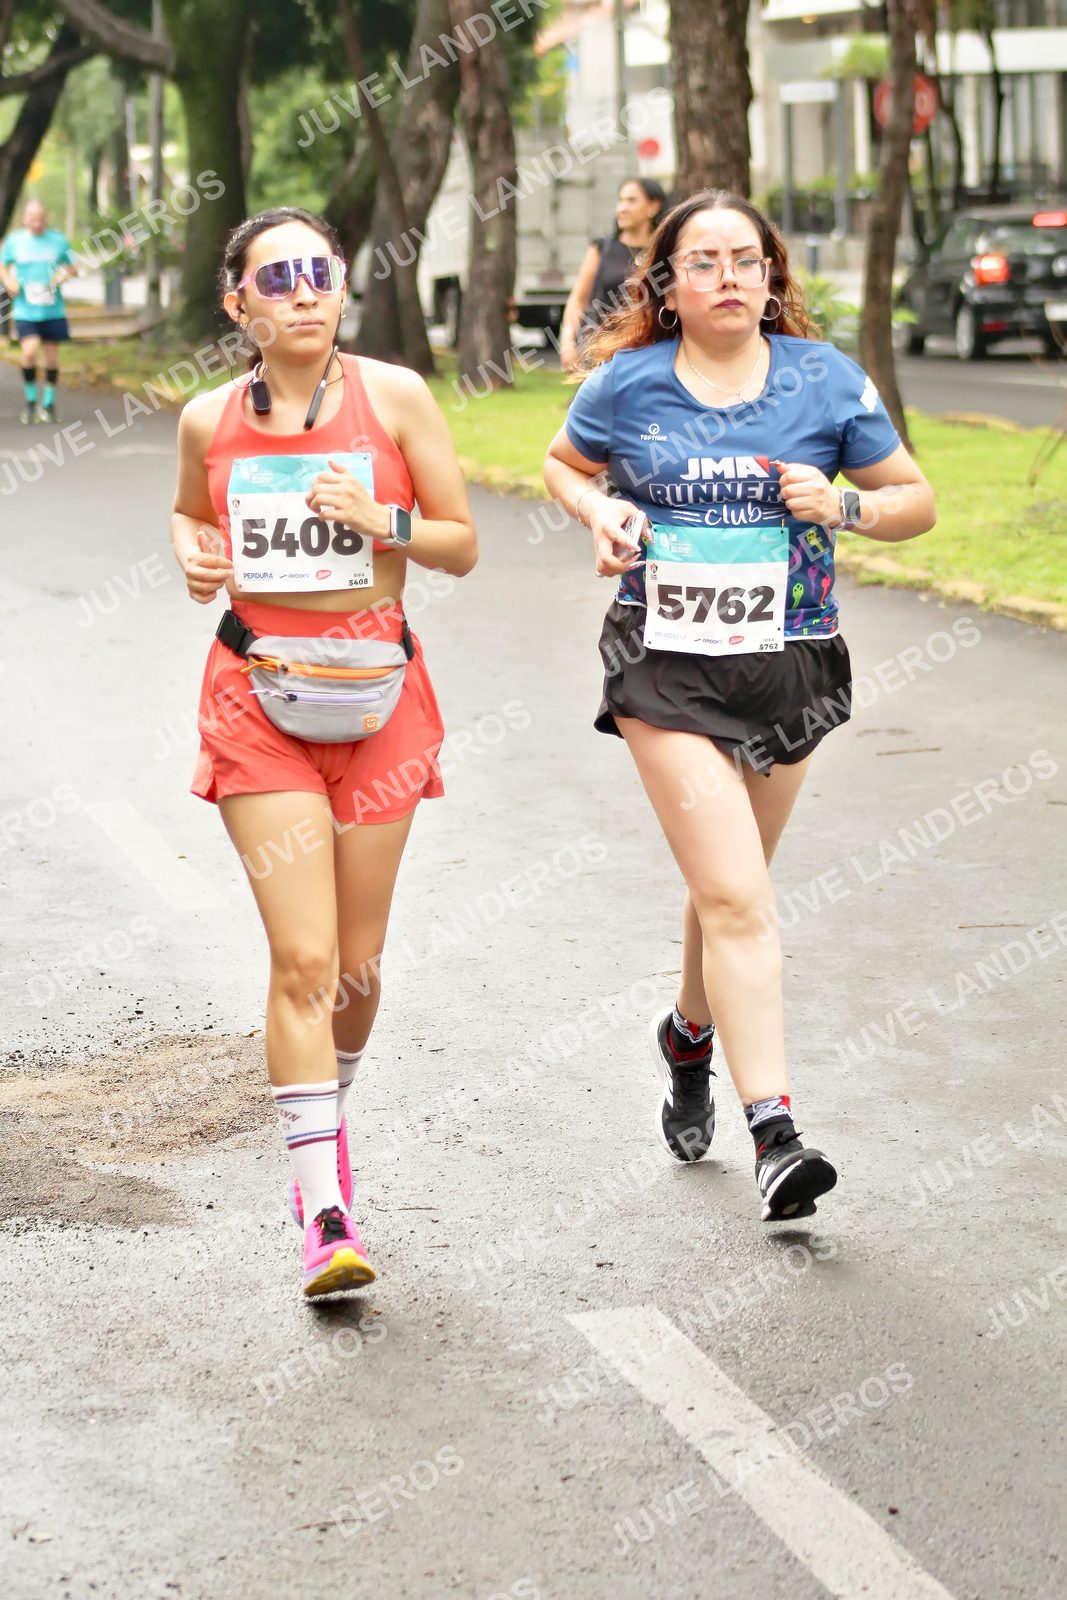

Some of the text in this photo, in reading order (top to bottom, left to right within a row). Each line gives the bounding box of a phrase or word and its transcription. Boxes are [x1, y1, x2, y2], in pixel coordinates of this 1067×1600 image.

[680, 456, 770, 481] JMA
[704, 502, 762, 526] club
[241, 516, 364, 559] 5408
[348, 578, 369, 586] 5408
[656, 584, 775, 625] 5762
